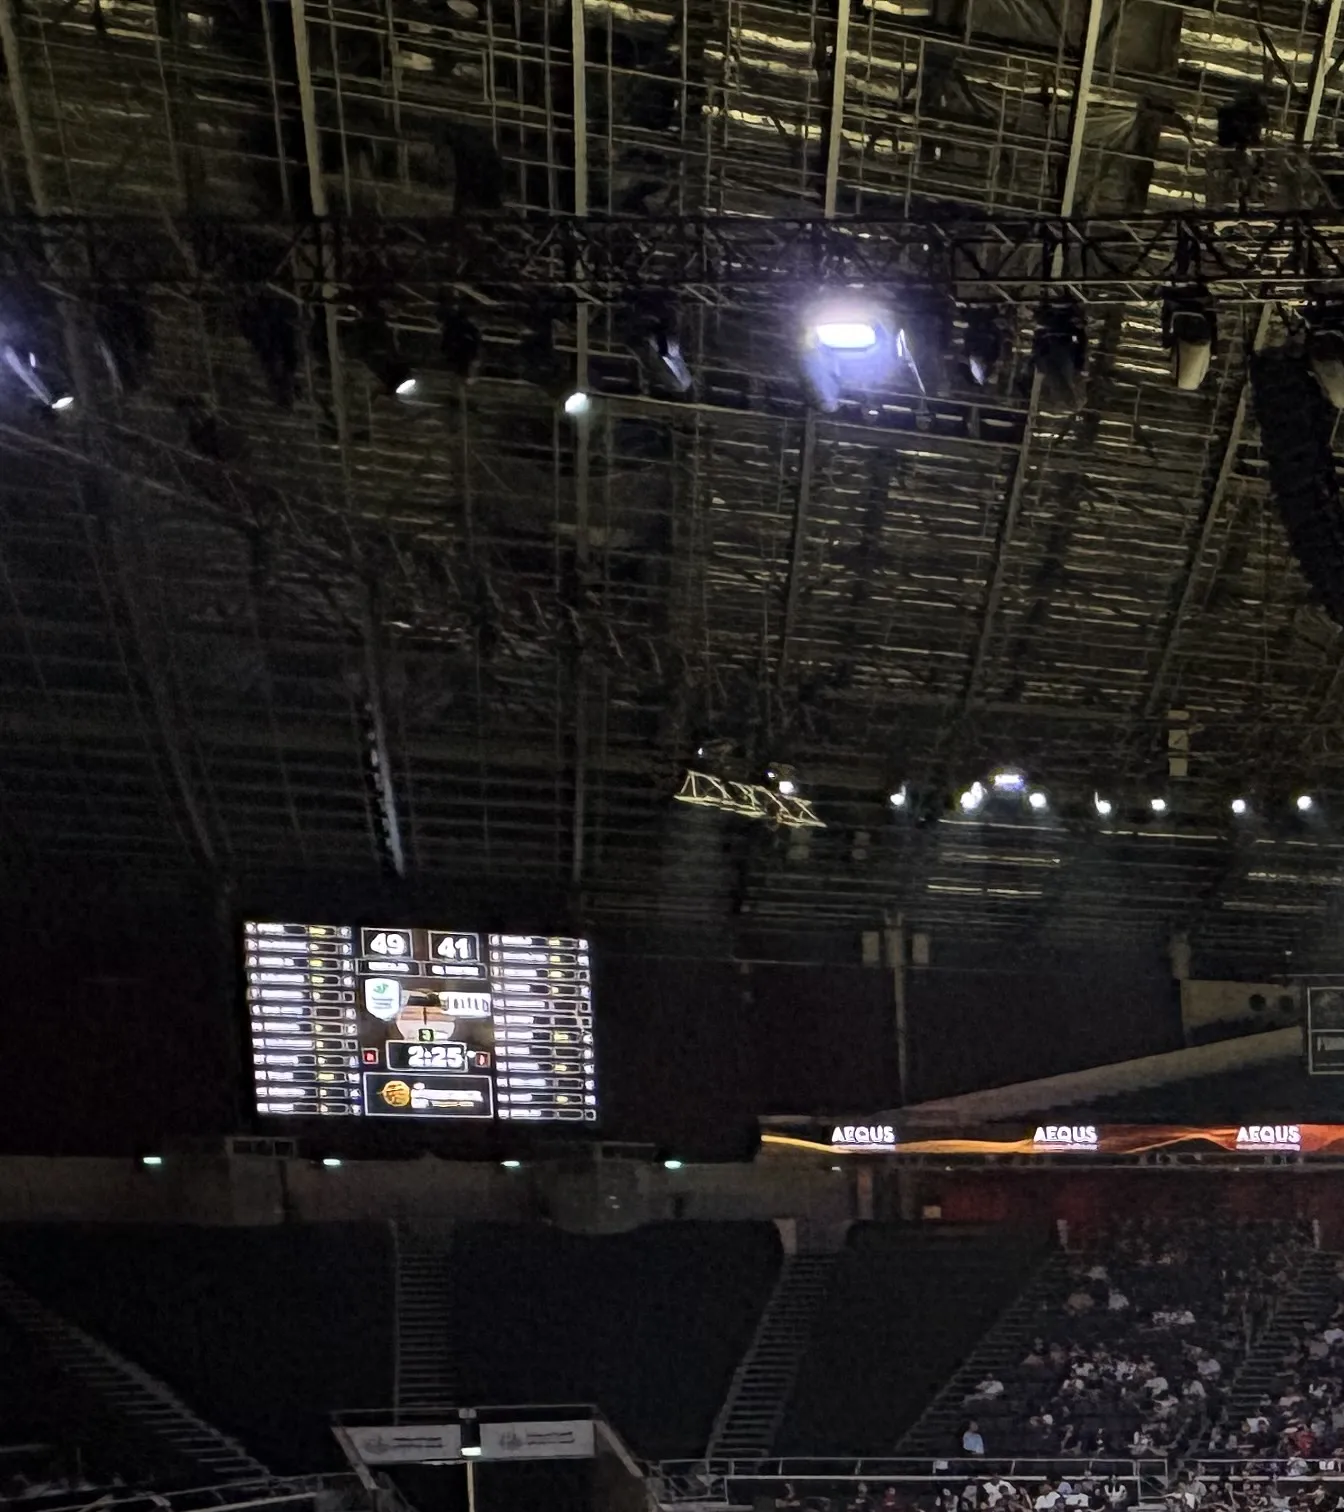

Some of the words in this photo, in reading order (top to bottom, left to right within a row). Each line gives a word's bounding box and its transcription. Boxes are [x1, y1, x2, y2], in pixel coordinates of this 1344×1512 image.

[370, 932, 405, 955] 49
[437, 936, 471, 959] 41
[407, 1045, 463, 1068] 2:25
[832, 1125, 895, 1143] AEQUS
[1034, 1125, 1097, 1143] AEQUS
[1238, 1125, 1302, 1143] AEQUS
